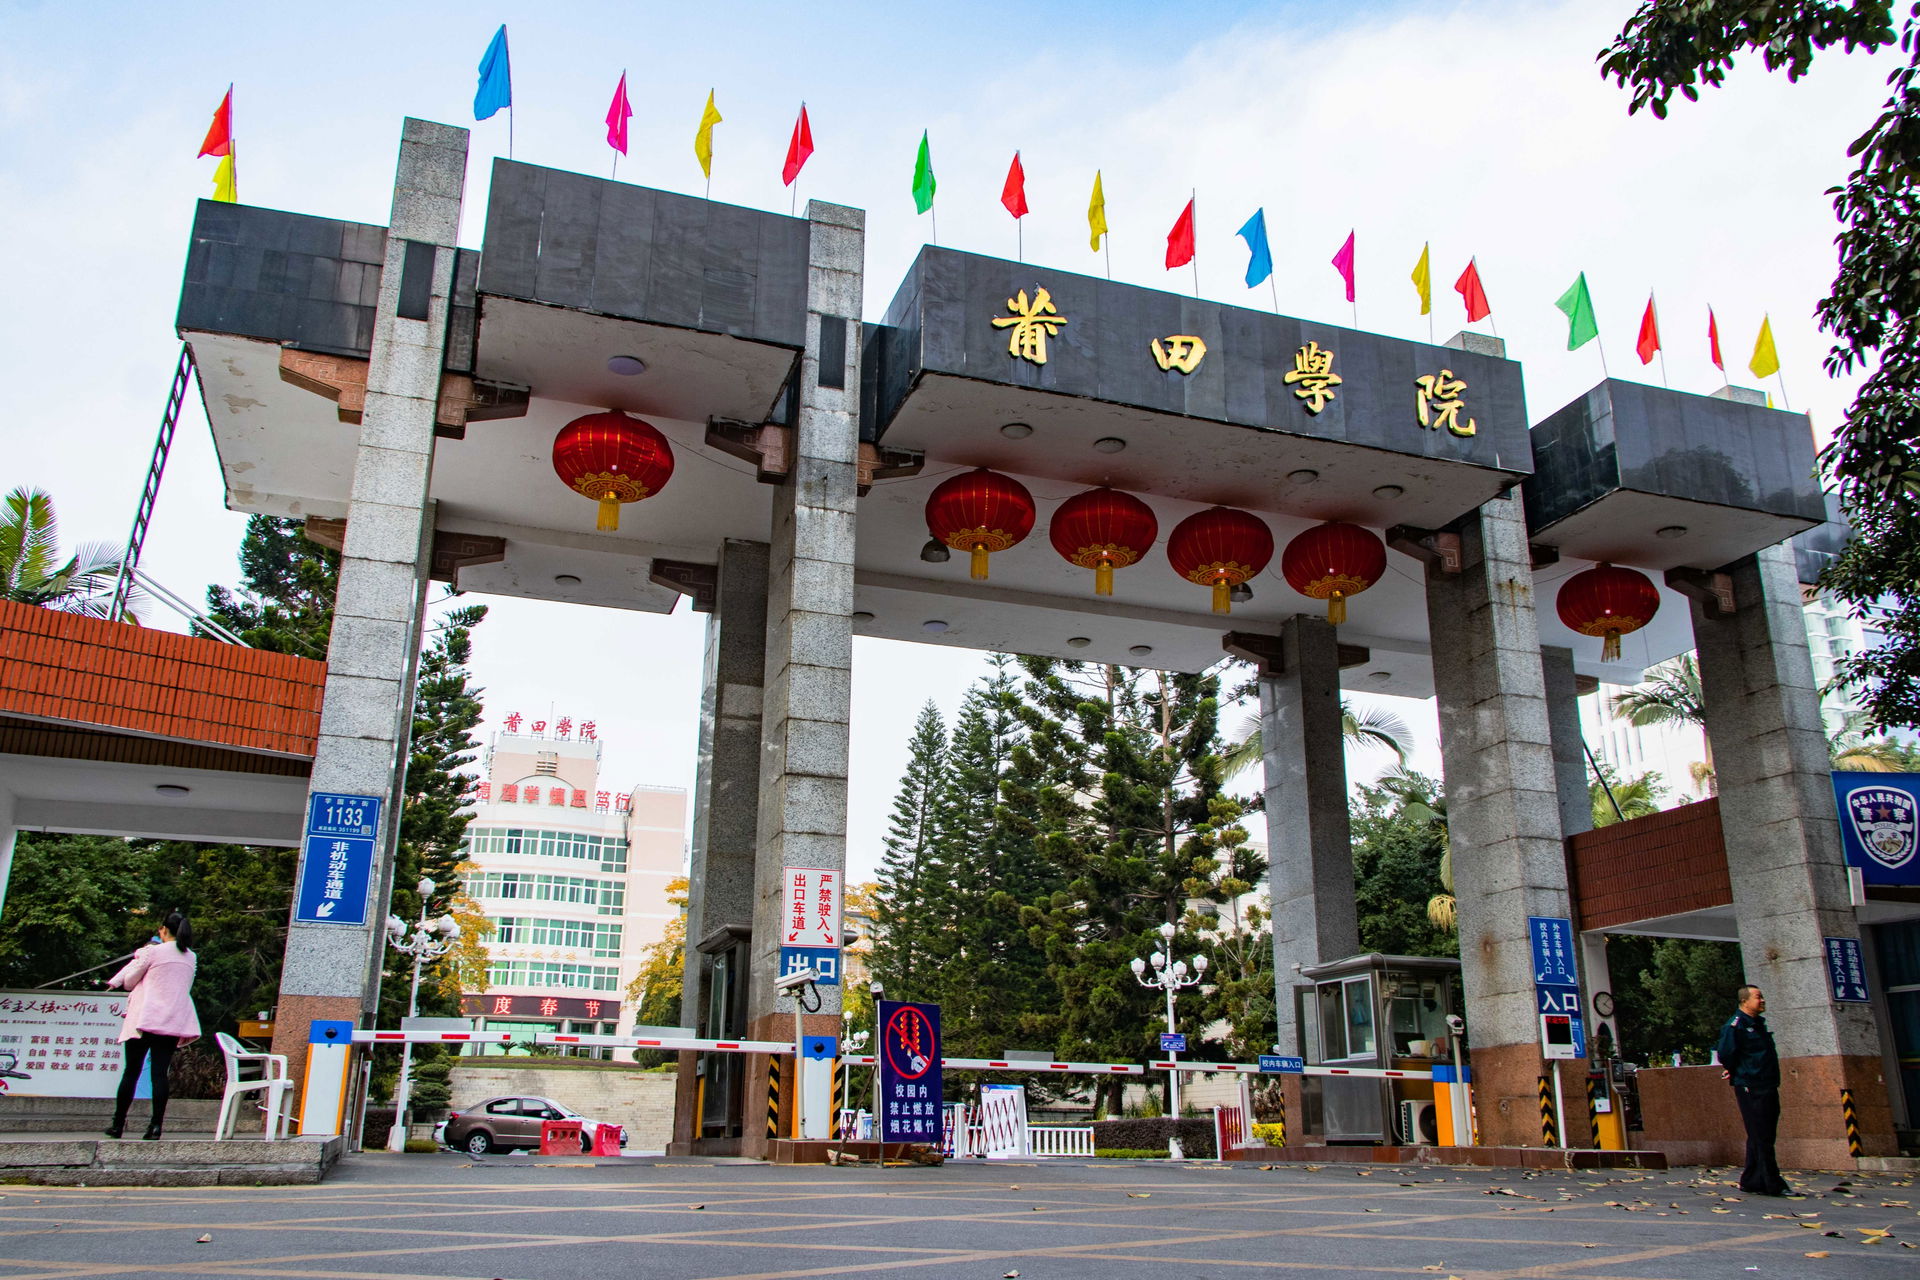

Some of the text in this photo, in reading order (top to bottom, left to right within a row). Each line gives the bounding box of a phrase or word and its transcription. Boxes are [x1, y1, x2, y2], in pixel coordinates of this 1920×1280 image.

[1851, 792, 1912, 810] 中华人民共和国
[327, 806, 363, 827] 1133
[324, 841, 350, 900] 非机动车通道
[792, 873, 806, 930] 出口车道
[817, 874, 833, 931] 严禁驶入
[1539, 922, 1552, 975] 校内车辆入口
[1552, 923, 1565, 975] 外来车辆入口
[787, 953, 836, 979] 出口
[460, 996, 601, 1018] 度春节
[1542, 990, 1579, 1012] 入口
[31, 1035, 50, 1044] 富强
[55, 1036, 74, 1045] 民主
[80, 1037, 99, 1045] 文明
[28, 1048, 47, 1057] 自由
[53, 1049, 73, 1058] 平等
[78, 1050, 97, 1058] 公正
[102, 1050, 121, 1059] 法治
[25, 1061, 45, 1070] 爱国
[100, 1063, 119, 1072] 友善
[895, 1084, 928, 1099] 校园内
[889, 1101, 935, 1116] 禁止燃放
[890, 1119, 935, 1134] 烟花爆竹
